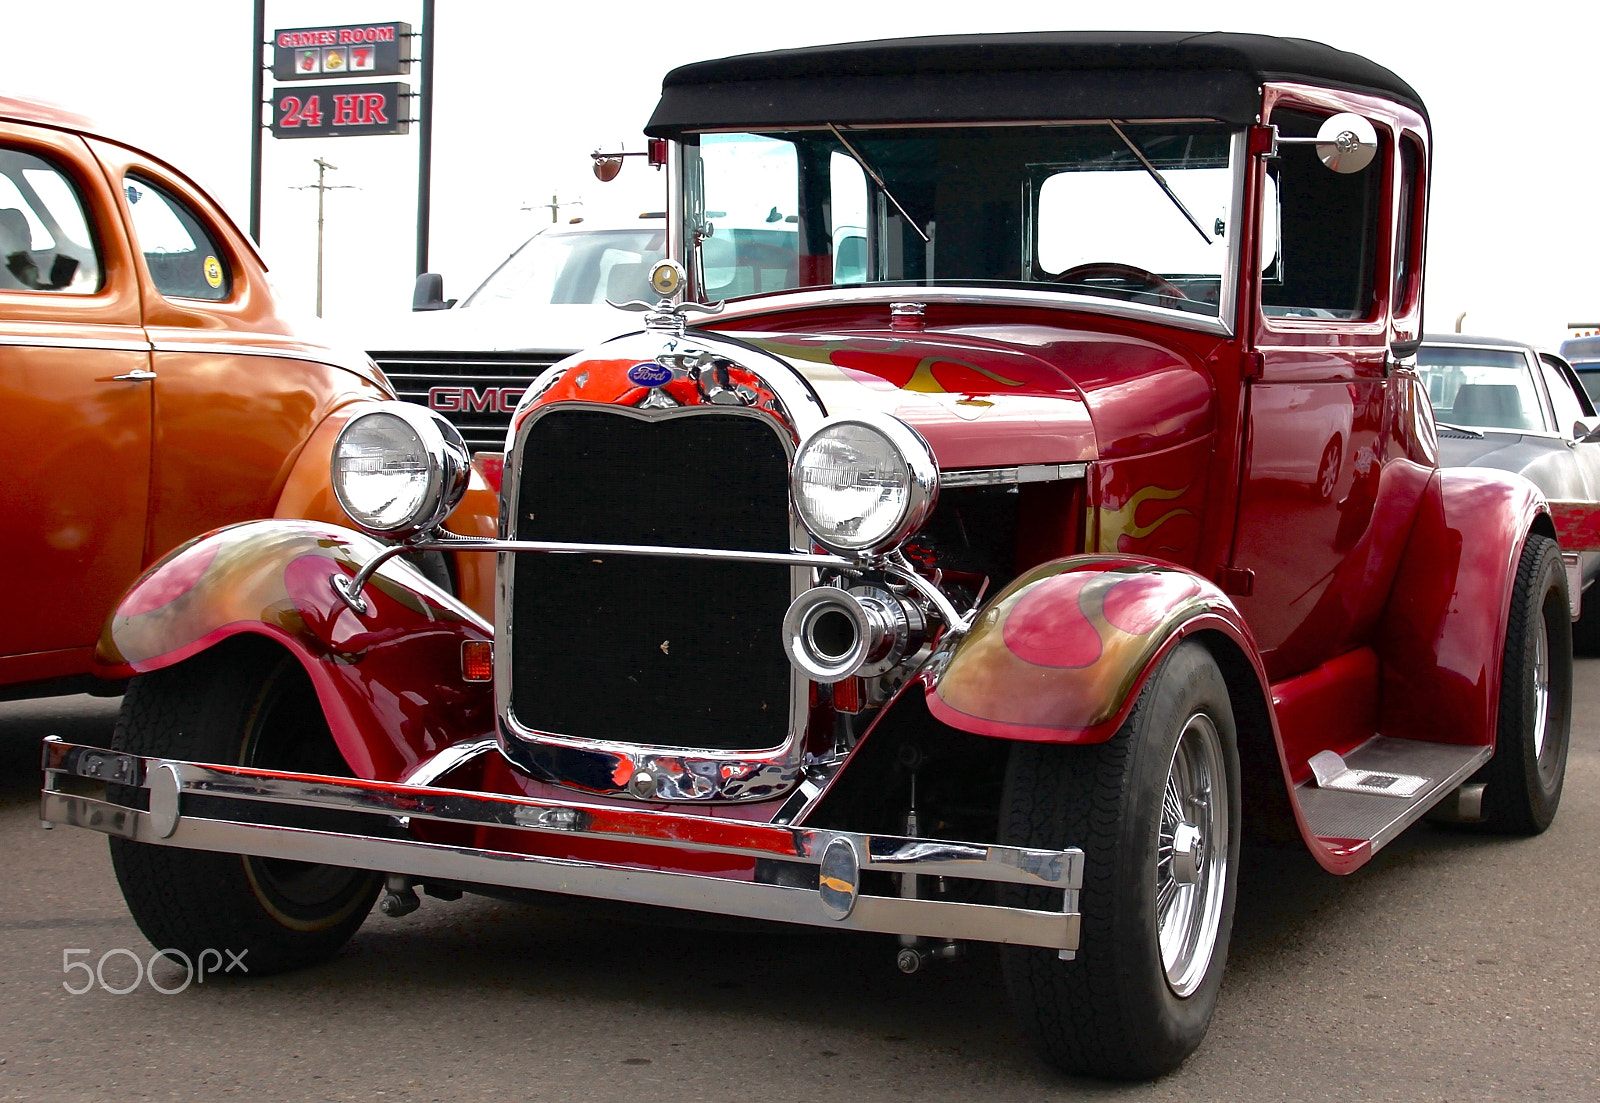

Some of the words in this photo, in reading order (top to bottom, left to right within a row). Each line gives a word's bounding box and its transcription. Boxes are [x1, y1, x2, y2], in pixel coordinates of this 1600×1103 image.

[277, 30, 337, 48] GAMES
[339, 26, 395, 44] ROOM
[353, 49, 370, 67] 7
[279, 95, 324, 128] 24
[332, 93, 389, 126] HR
[633, 366, 666, 381] Ford
